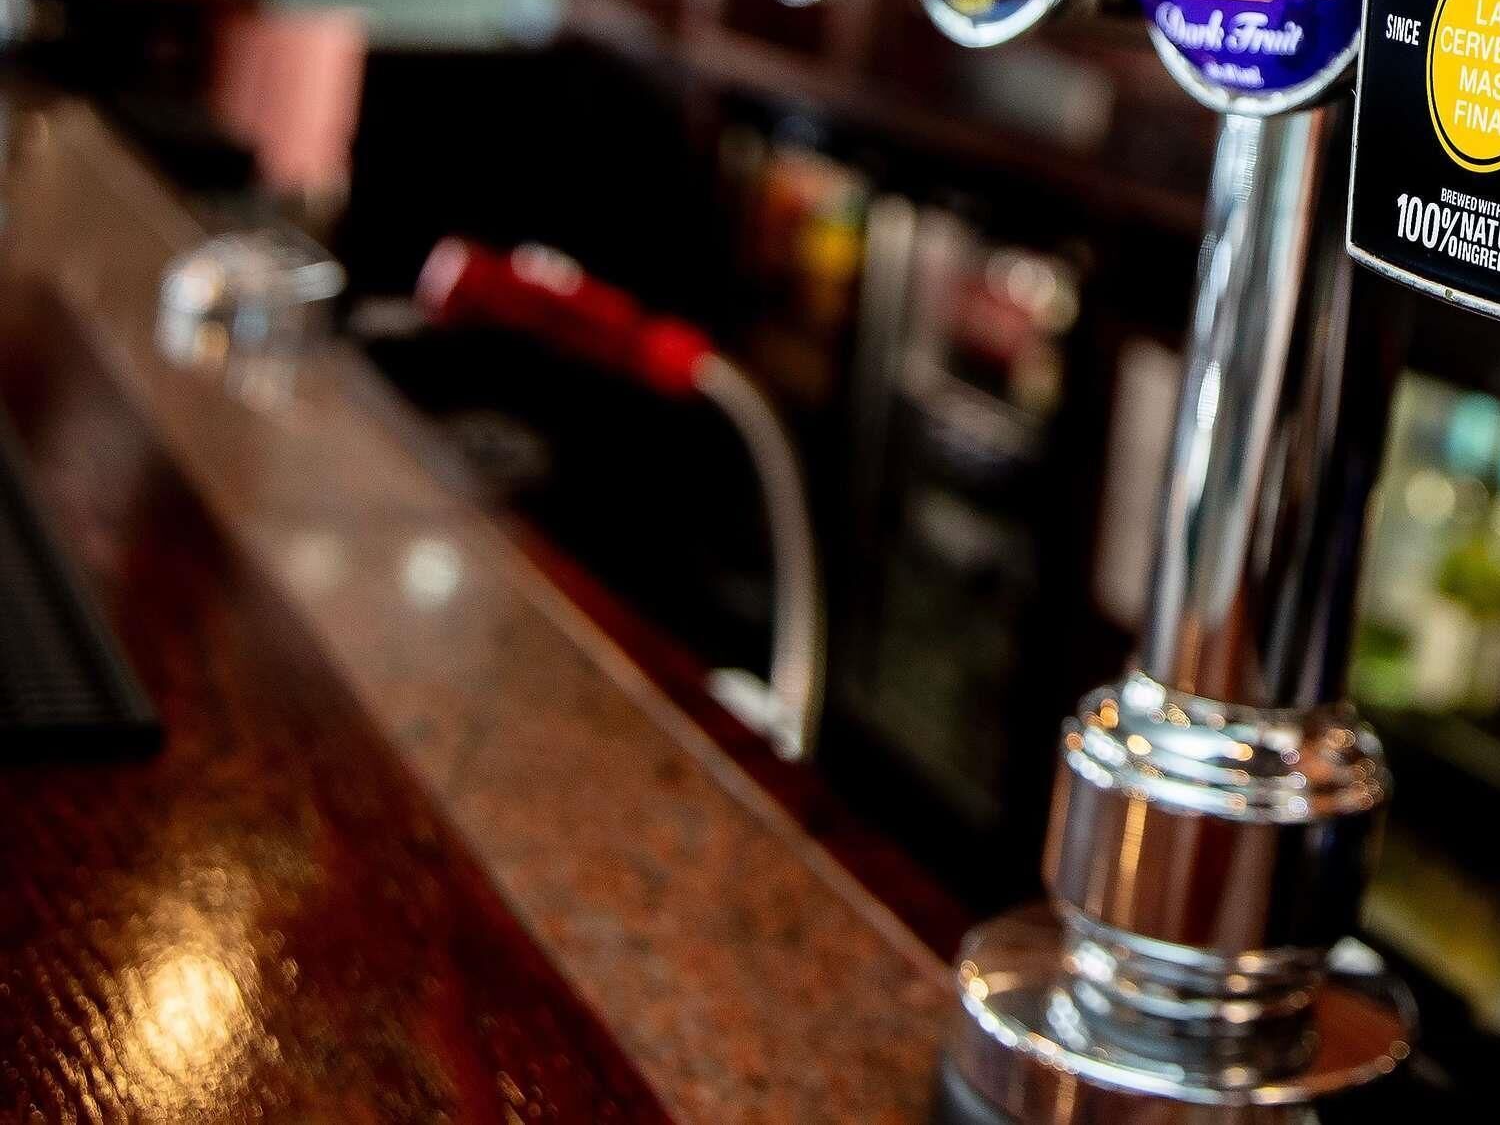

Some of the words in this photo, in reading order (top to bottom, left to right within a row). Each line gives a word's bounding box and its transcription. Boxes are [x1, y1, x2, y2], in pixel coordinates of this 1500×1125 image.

[1227, 12, 1304, 55] Fruit
[1385, 13, 1421, 47] SINCE
[1440, 187, 1477, 212] BREWED
[1397, 193, 1458, 258] 100%
